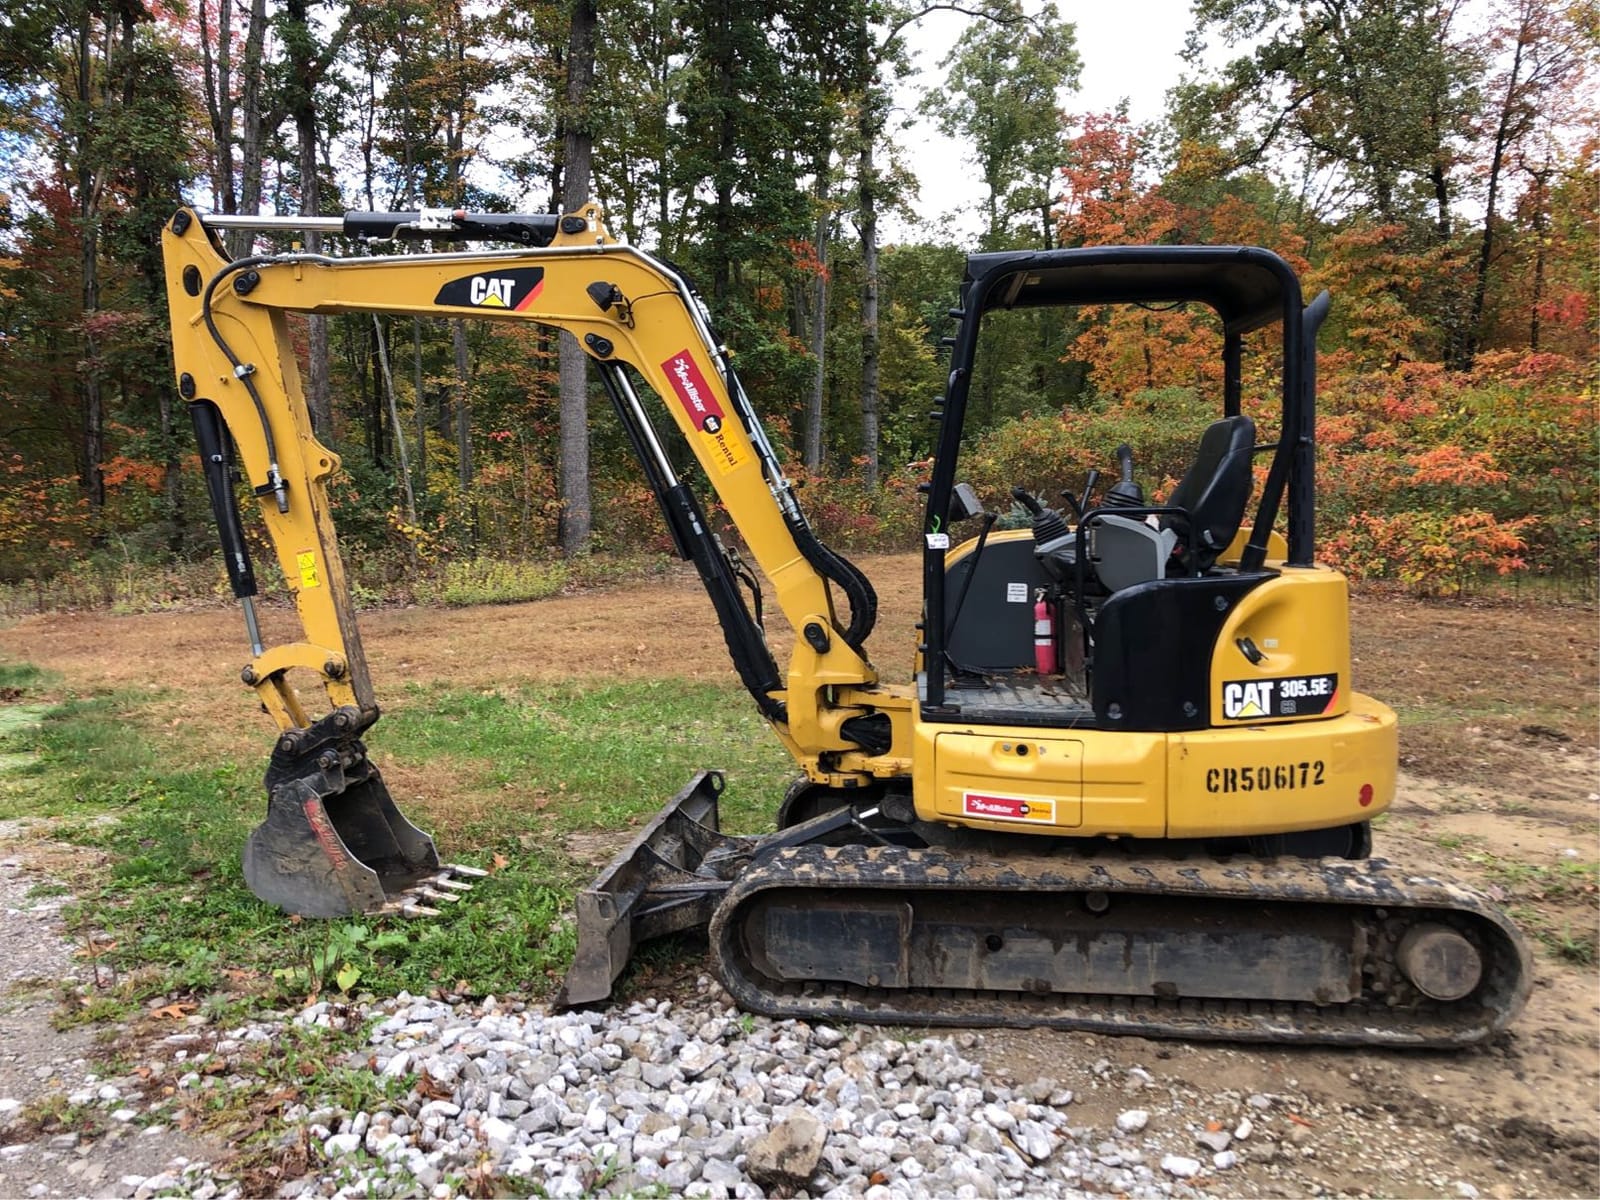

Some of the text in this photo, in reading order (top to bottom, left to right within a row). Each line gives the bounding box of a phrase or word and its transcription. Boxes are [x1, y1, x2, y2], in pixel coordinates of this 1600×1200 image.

[470, 276, 515, 307] CAT
[715, 434, 738, 466] Rental
[1224, 682, 1274, 718] CAT
[1206, 760, 1325, 793] CR506172
